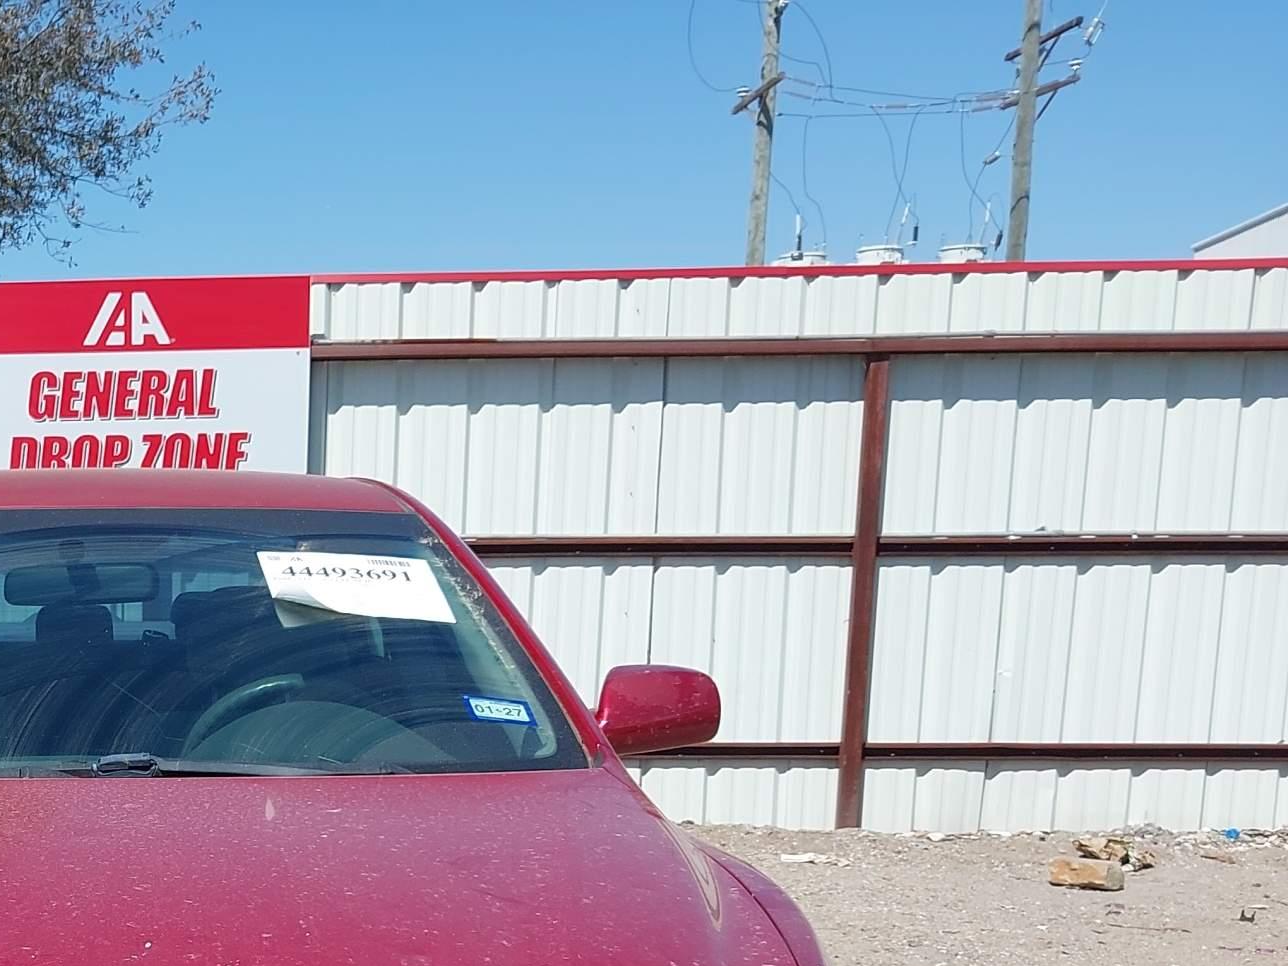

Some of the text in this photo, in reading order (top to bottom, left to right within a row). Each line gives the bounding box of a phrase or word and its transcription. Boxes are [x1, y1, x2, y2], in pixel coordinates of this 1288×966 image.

[27, 368, 219, 422] GENERAL
[9, 434, 133, 470] DROP
[281, 565, 412, 583] 44493691
